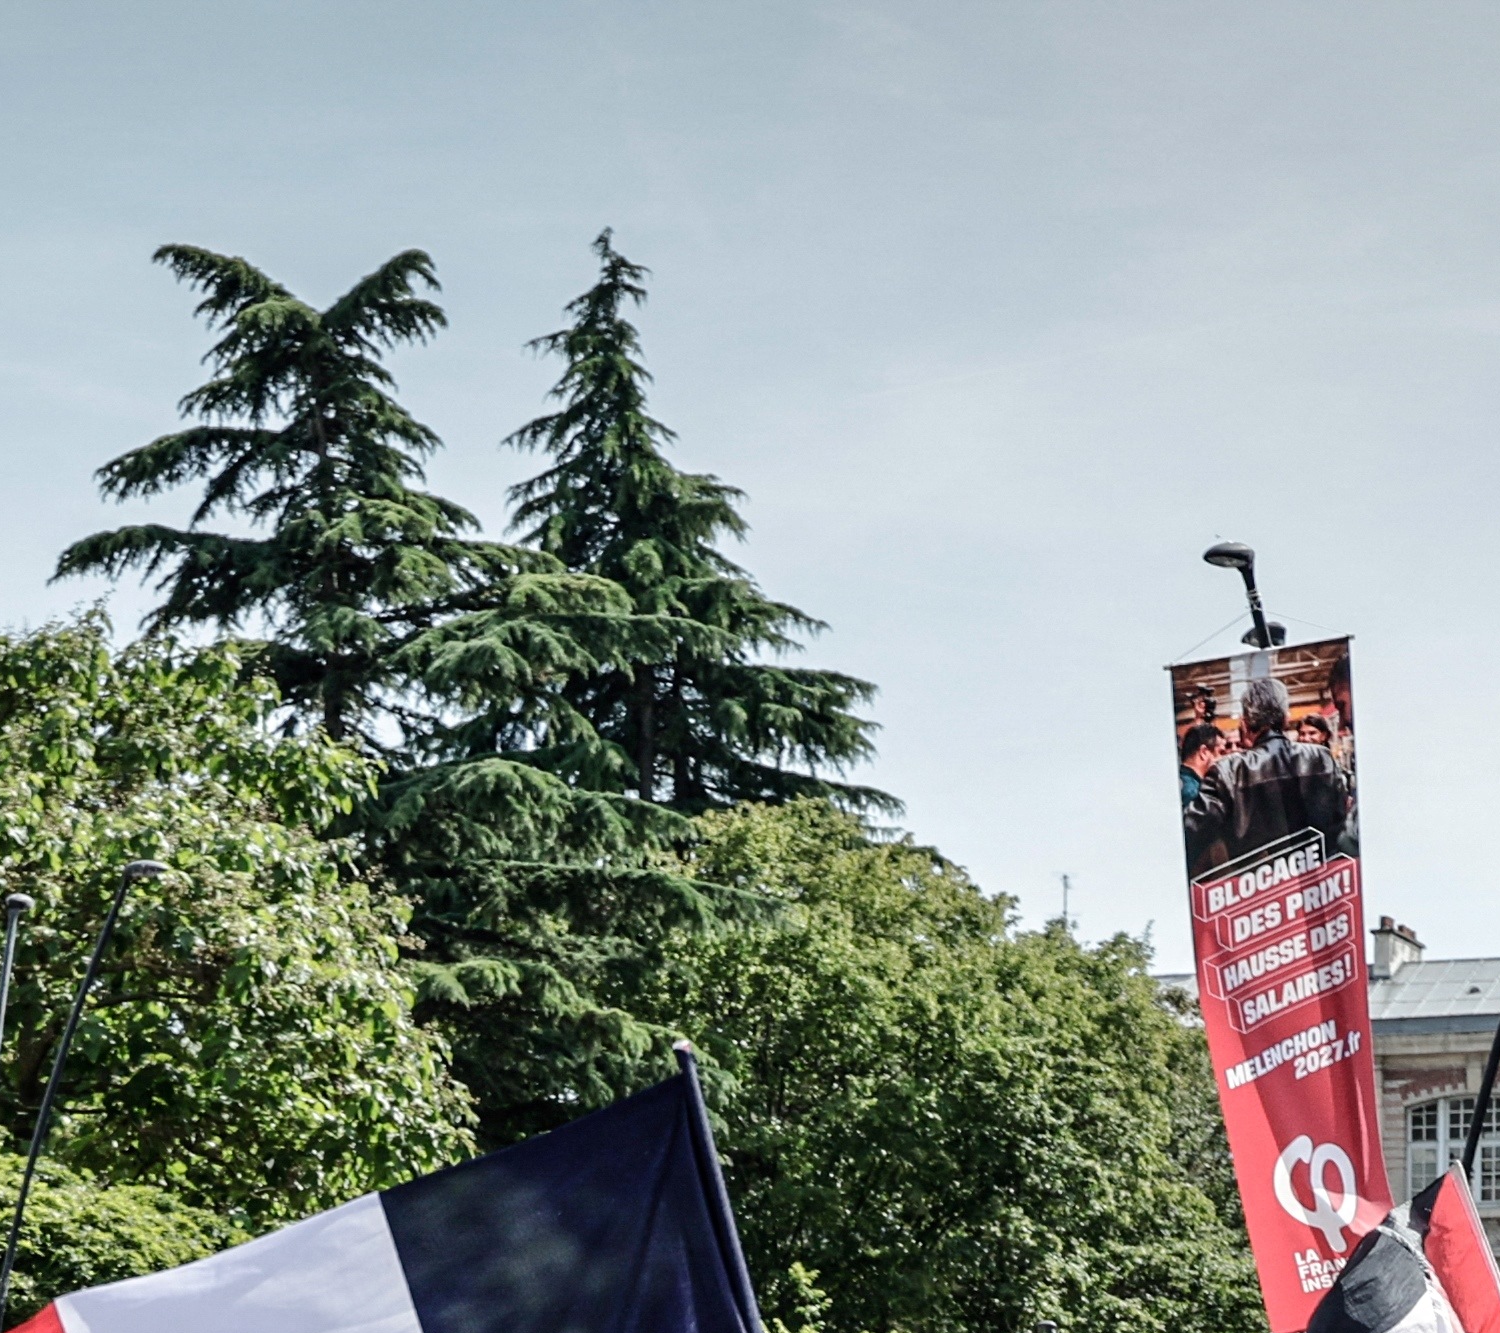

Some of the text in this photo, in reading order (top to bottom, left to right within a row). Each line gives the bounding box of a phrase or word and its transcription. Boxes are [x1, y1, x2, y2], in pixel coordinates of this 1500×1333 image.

[1208, 843, 1321, 913] BLOCAGE
[1234, 869, 1351, 943] DES PRIX!
[1223, 913, 1349, 991] HAUSSE DES
[1243, 953, 1352, 1025] SALAIRES!
[1225, 1019, 1337, 1089] MELENCHON
[1293, 1030, 1361, 1080] 2027.fr
[1294, 1248, 1320, 1265] LA
[1298, 1257, 1348, 1280] FRAN
